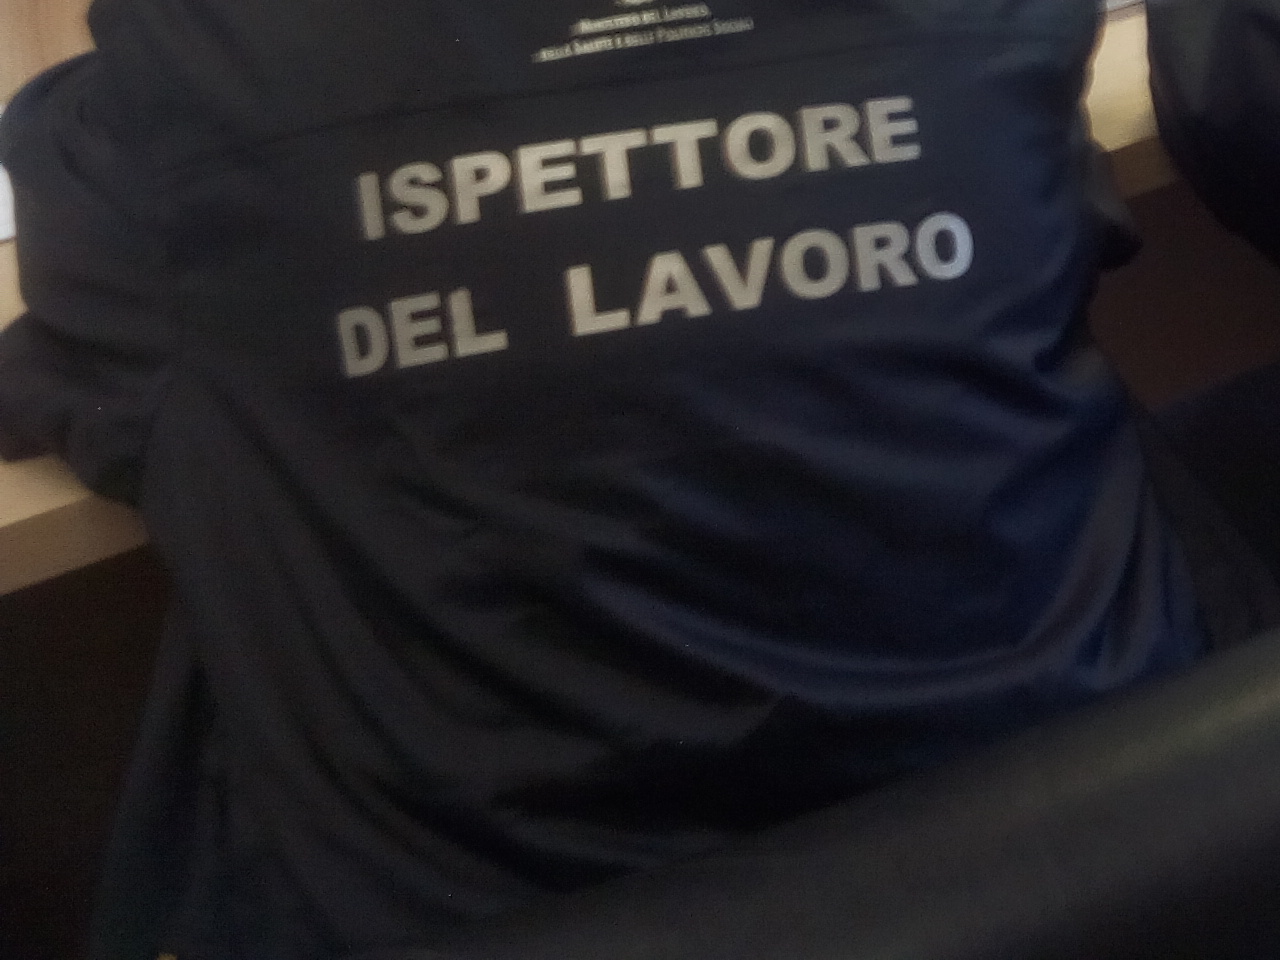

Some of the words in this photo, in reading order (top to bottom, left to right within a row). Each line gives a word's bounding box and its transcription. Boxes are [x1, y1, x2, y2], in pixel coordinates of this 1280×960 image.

[356, 96, 921, 241] ISPETTORE
[336, 287, 509, 379] DEL
[563, 211, 974, 337] LAVORO
